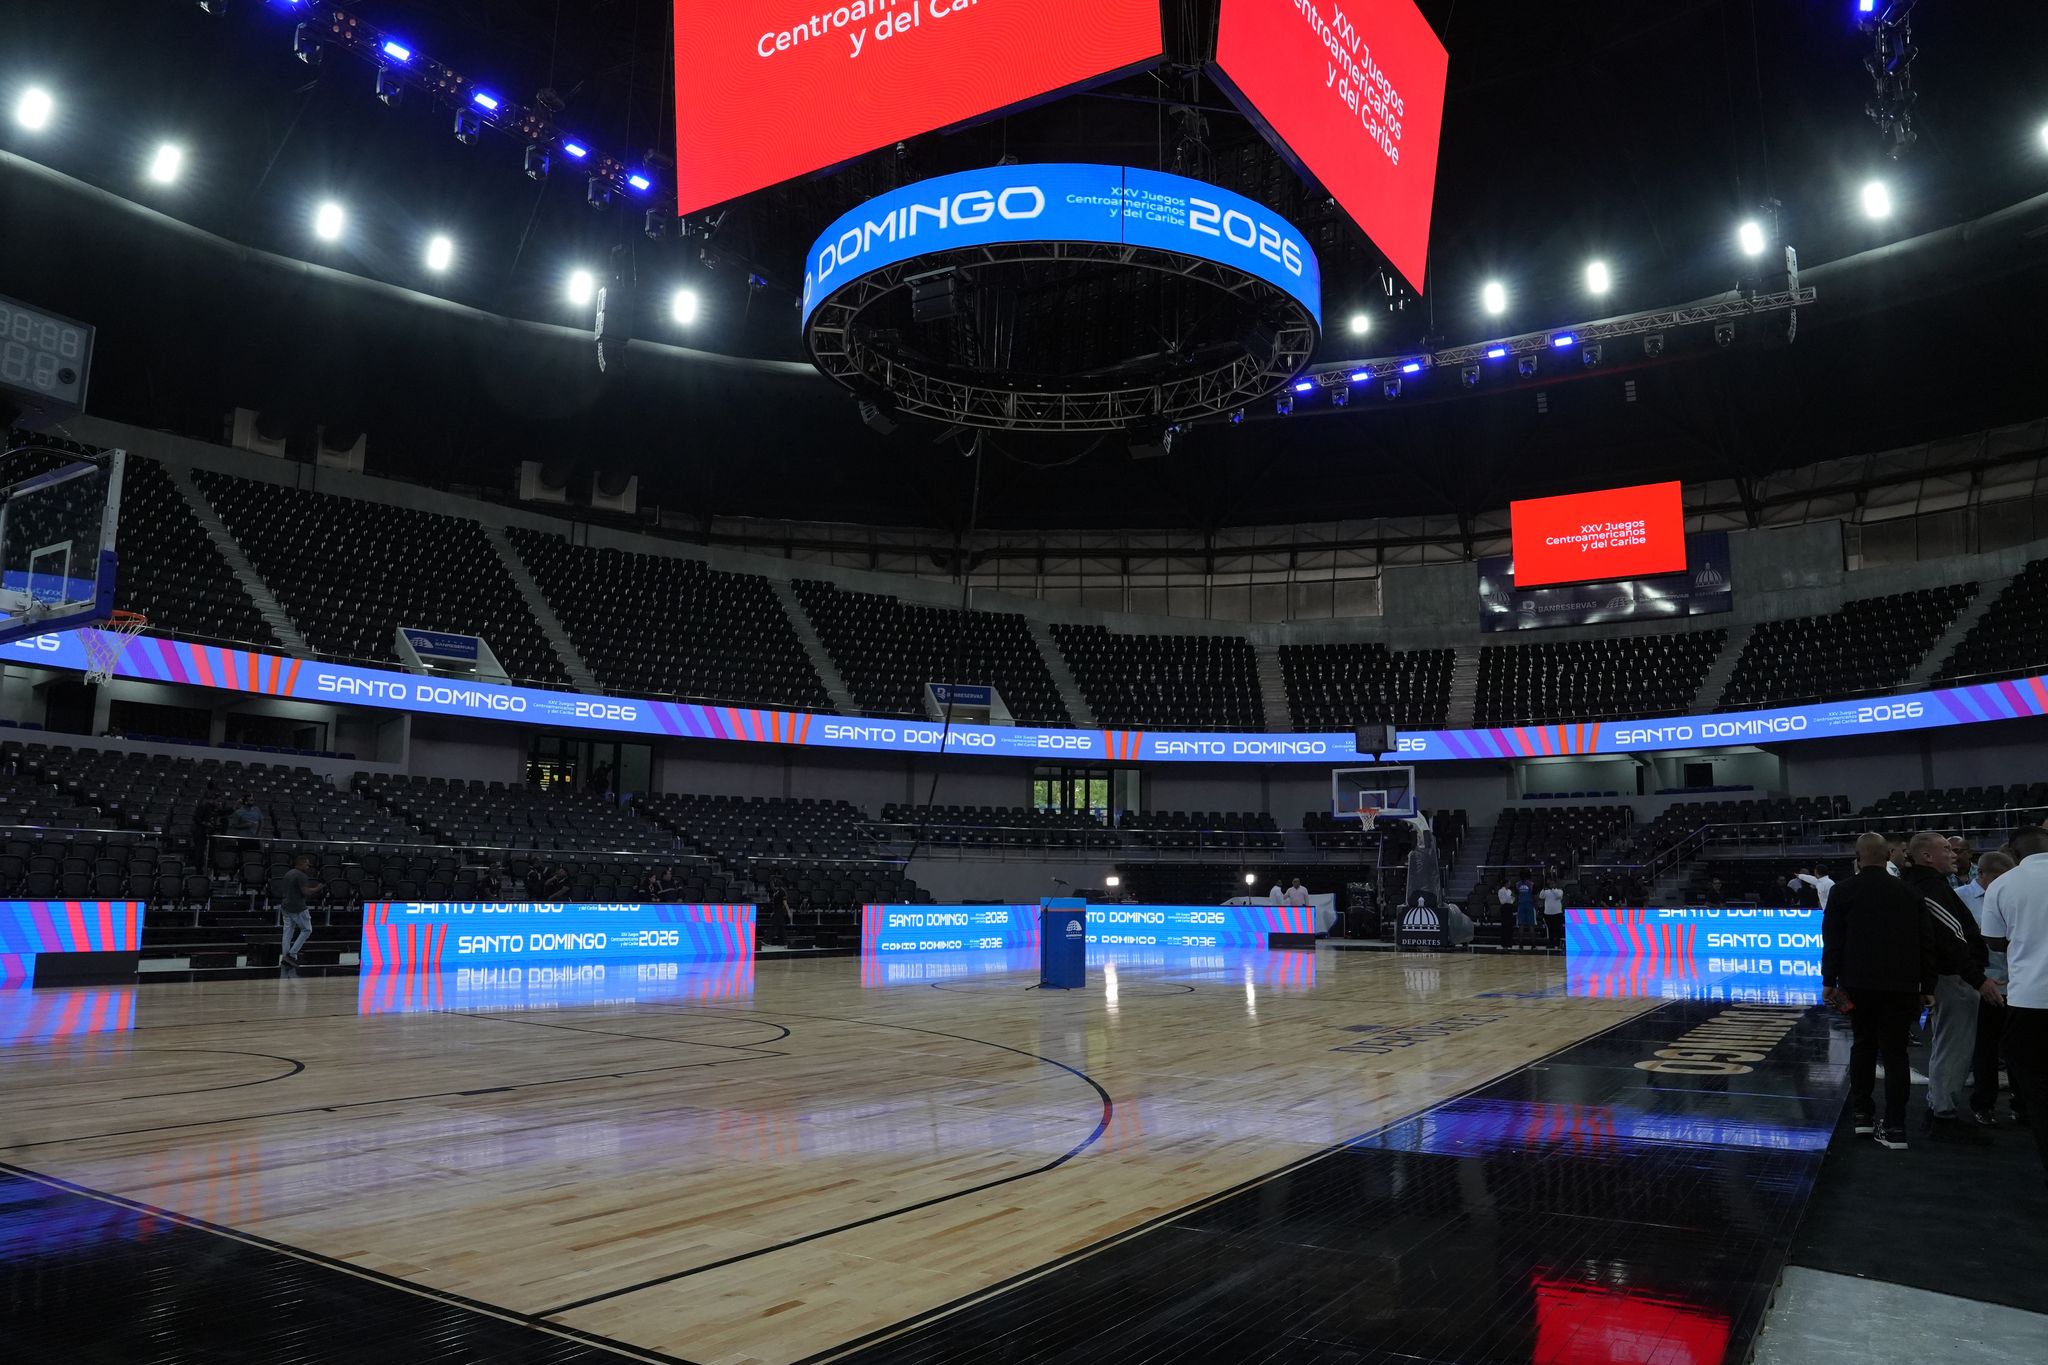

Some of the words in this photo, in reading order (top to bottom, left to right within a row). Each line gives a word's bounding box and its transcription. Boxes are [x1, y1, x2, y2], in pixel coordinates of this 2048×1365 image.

[849, 28, 867, 58] y
[874, 0, 919, 41] del
[1332, 3, 1360, 54] XXV
[1361, 44, 1404, 117] Juegos
[1326, 61, 1337, 87] y
[1338, 77, 1359, 115] del
[1362, 104, 1399, 165] Caribe
[1066, 194, 1185, 217] Centroamericanos
[1110, 187, 1139, 198] XXV
[1141, 190, 1185, 206] Juegos
[1109, 208, 1118, 218] y
[1120, 208, 1142, 218] del
[1145, 211, 1185, 226] Caribe
[818, 186, 1045, 284] DOMINGO
[1189, 197, 1303, 277] 2026
[1545, 526, 1646, 546] Centroamericanos
[1580, 523, 1603, 534] XXV
[1605, 520, 1645, 532] Juegos
[1581, 542, 1589, 552] y
[1591, 538, 1608, 550] del
[1610, 536, 1646, 548] Caribe
[1538, 600, 1597, 613] BANRESERVAS
[317, 673, 407, 700] SANTO
[416, 685, 526, 712] DOMINGO
[575, 701, 637, 721] 2026
[1858, 701, 1924, 723] 2026
[824, 724, 896, 742] SANTO
[903, 729, 996, 747] DOMINGO
[1037, 734, 1092, 749] 2026
[1615, 726, 1692, 745] SANTO
[1701, 715, 1807, 738] DOMINGO
[1155, 741, 1225, 754] SANTO
[1233, 741, 1326, 754] DOMINGO
[888, 913, 923, 927] SANTO
[926, 913, 968, 926] DOMINGO
[985, 911, 1008, 924] 2026
[1109, 911, 1165, 924] DOMINGO
[1190, 911, 1225, 924] 2026
[458, 935, 523, 954] SANTO
[530, 932, 607, 951] DOMINGO
[639, 930, 679, 947] 2026
[1401, 938, 1441, 946] DEPORTES
[1707, 933, 1771, 948] SANTO
[1633, 1010, 1806, 1075] DOMINGO
